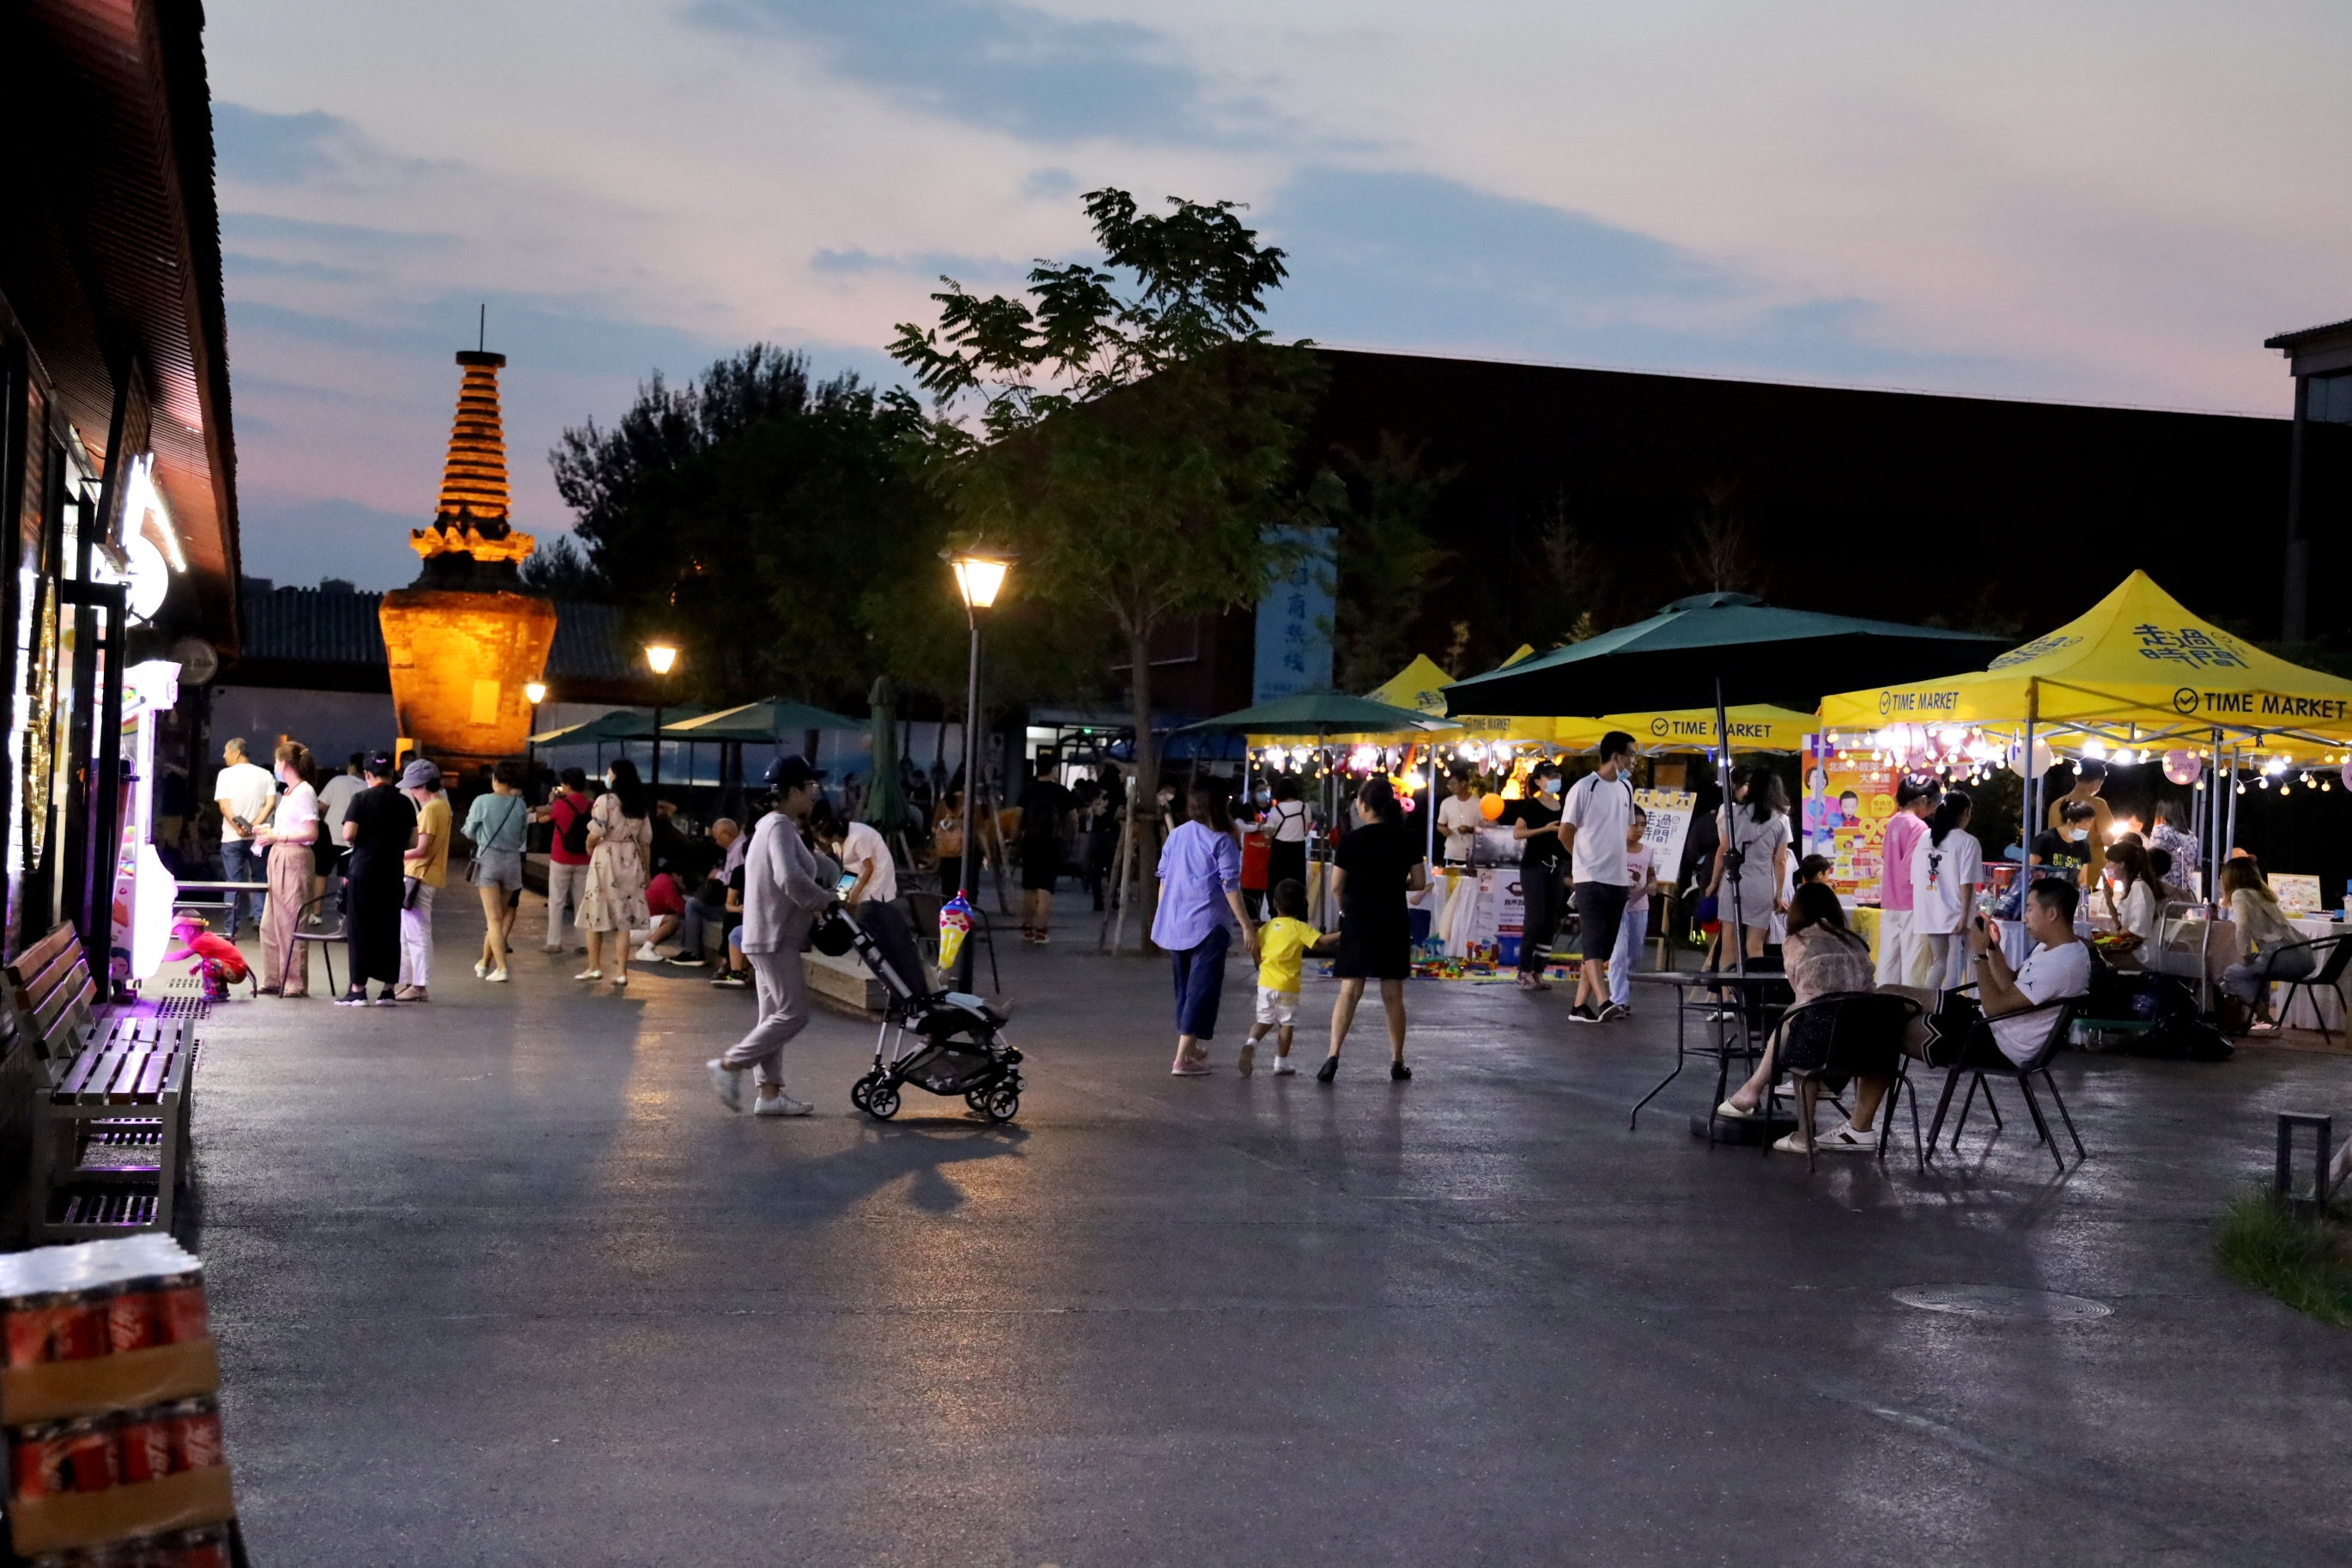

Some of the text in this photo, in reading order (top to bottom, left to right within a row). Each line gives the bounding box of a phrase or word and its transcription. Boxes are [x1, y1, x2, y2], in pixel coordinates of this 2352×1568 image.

[2132, 623, 2221, 649] 走過
[2138, 647, 2250, 670] 時間
[1893, 691, 1960, 711] TIME MARKET
[2204, 692, 2348, 720] TIME MARKET
[1473, 718, 1511, 731] TIME MARKET
[1673, 721, 1707, 735] TIME
